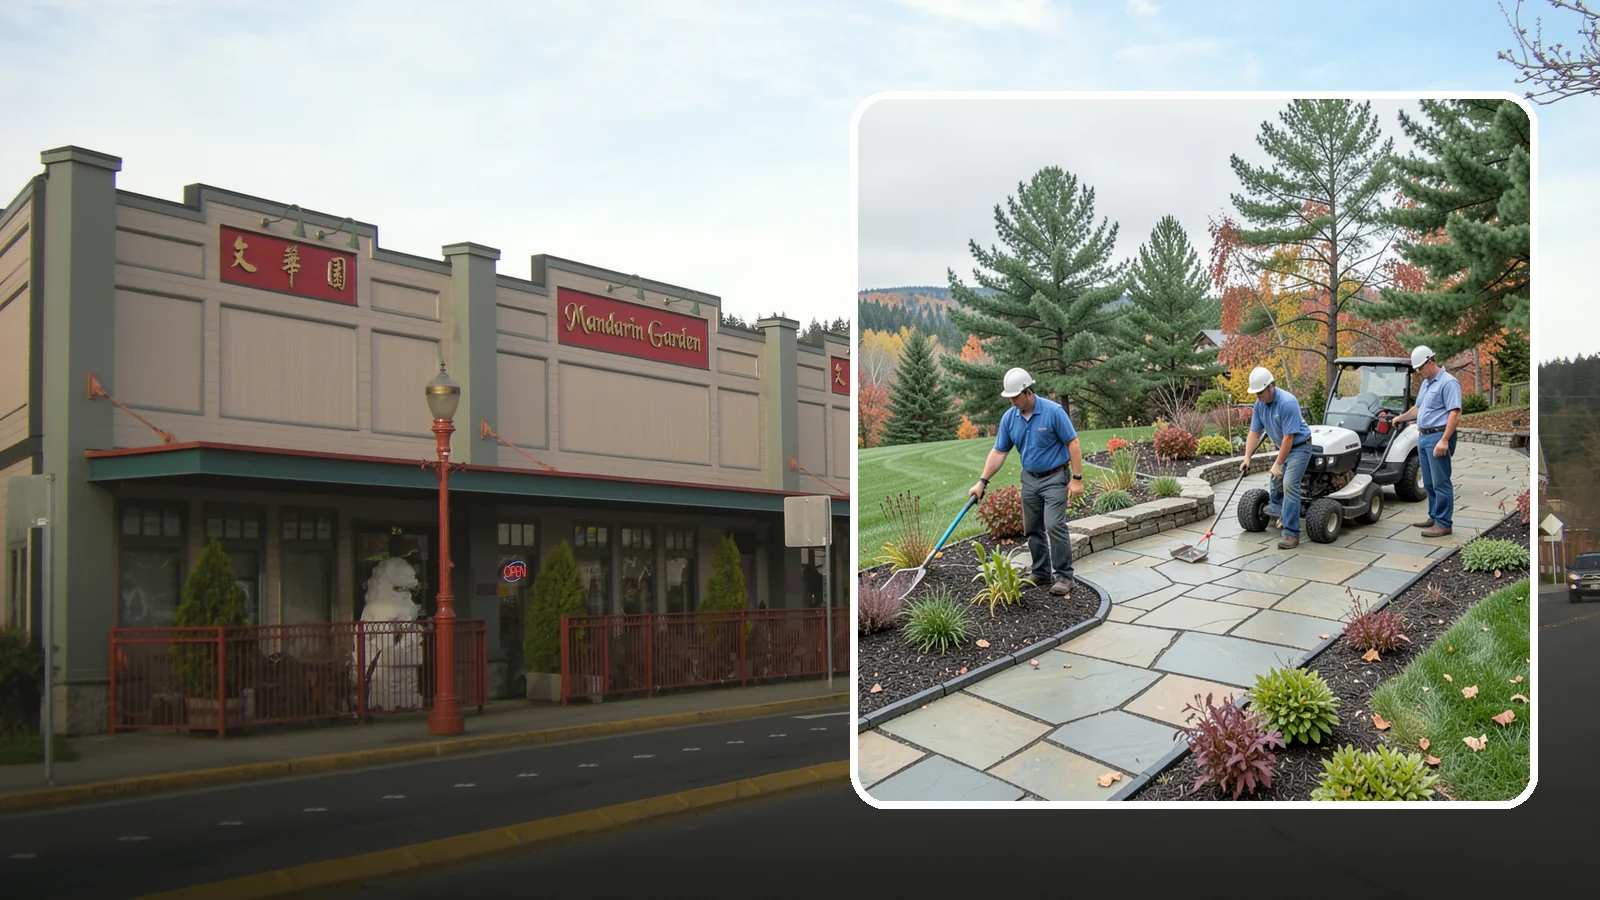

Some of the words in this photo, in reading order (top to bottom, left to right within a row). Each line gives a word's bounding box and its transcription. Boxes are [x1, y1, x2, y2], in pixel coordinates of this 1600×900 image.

[564, 302, 644, 341] Mandarin
[648, 320, 701, 352] Garden
[504, 565, 527, 578] OPEN
